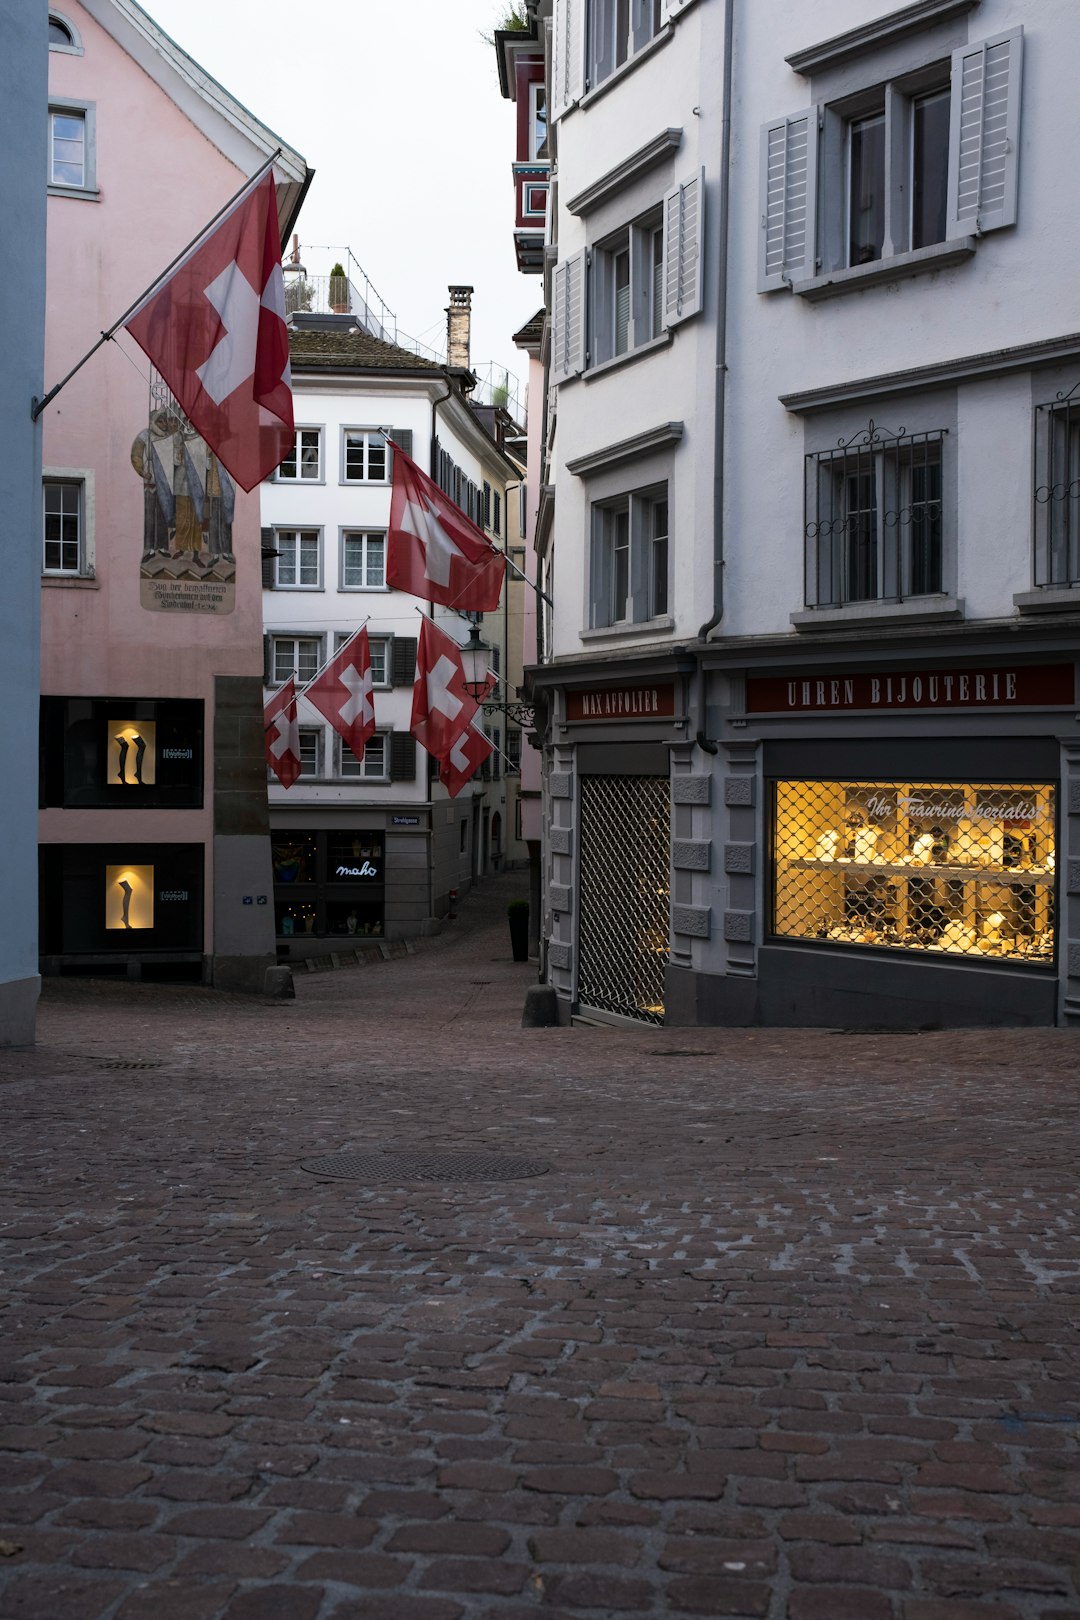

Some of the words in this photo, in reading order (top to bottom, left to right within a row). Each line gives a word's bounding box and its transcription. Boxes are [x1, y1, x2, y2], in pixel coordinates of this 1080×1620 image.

[787, 679, 854, 706] UHREN
[871, 673, 1017, 703] BIJOUTERIE
[583, 694, 602, 715] MAX
[605, 690, 658, 713] AFFOLTER
[867, 797, 892, 817] Ihr
[335, 861, 377, 876] maho
